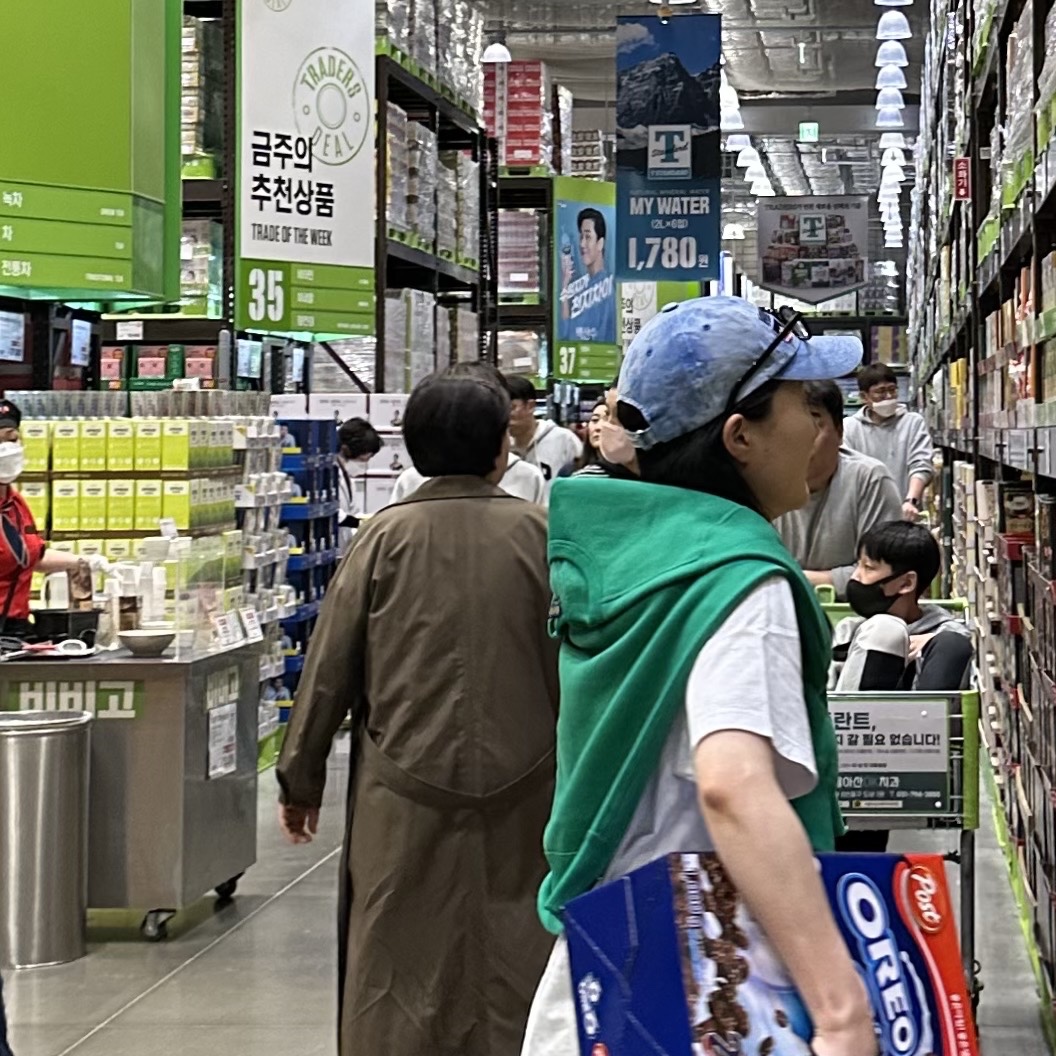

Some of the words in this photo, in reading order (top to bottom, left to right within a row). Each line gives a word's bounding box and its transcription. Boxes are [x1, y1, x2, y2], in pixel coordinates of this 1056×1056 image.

[300, 55, 362, 98] TRADERS
[251, 130, 313, 173] 금주의
[311, 126, 354, 158] DEAL
[250, 173, 335, 218] 추천상품
[629, 196, 655, 216] MY
[656, 196, 710, 215] WATER
[251, 223, 280, 243] TRADE
[281, 224, 292, 243] OF
[293, 226, 309, 245] THE
[310, 229, 333, 247] WEEK
[248, 268, 285, 322] 35
[559, 346, 576, 375] 37
[19, 680, 136, 719] 비비고
[828, 711, 877, 732] 란트,
[889, 733, 941, 746] 없습니다!
[910, 871, 942, 927] Post
[846, 881, 914, 1053] OREO
